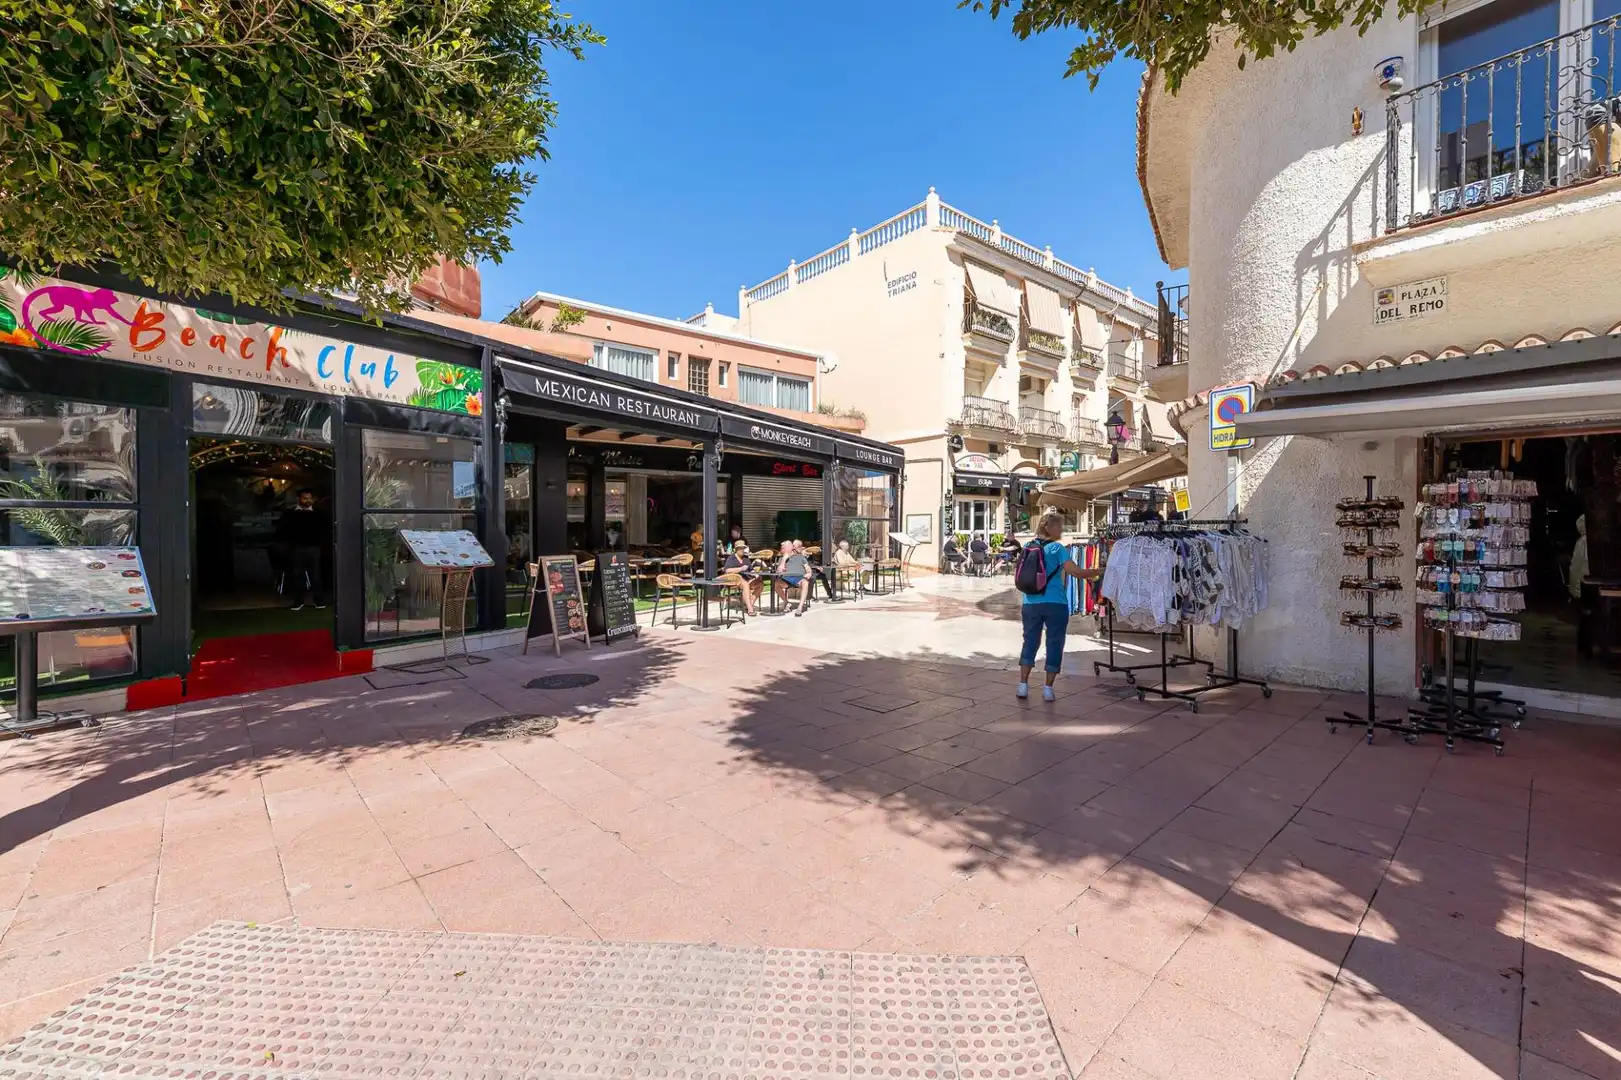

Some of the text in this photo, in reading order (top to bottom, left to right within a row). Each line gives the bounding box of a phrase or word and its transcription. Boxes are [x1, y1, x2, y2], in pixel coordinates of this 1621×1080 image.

[888, 271, 917, 289] EDIFICIO
[888, 281, 917, 298] TRIANA
[1401, 286, 1437, 300] PLAZA
[1380, 299, 1444, 320] DEL REMO
[129, 301, 399, 389] Beach Club
[132, 352, 197, 369] FUSION
[207, 364, 301, 386] RESTAURANT
[323, 383, 373, 396] LOUNGE
[535, 378, 701, 426] MEXICAN RESTAURANT
[760, 428, 812, 448] MONKEYBEACH
[855, 449, 893, 465] LOUNGE BAR
